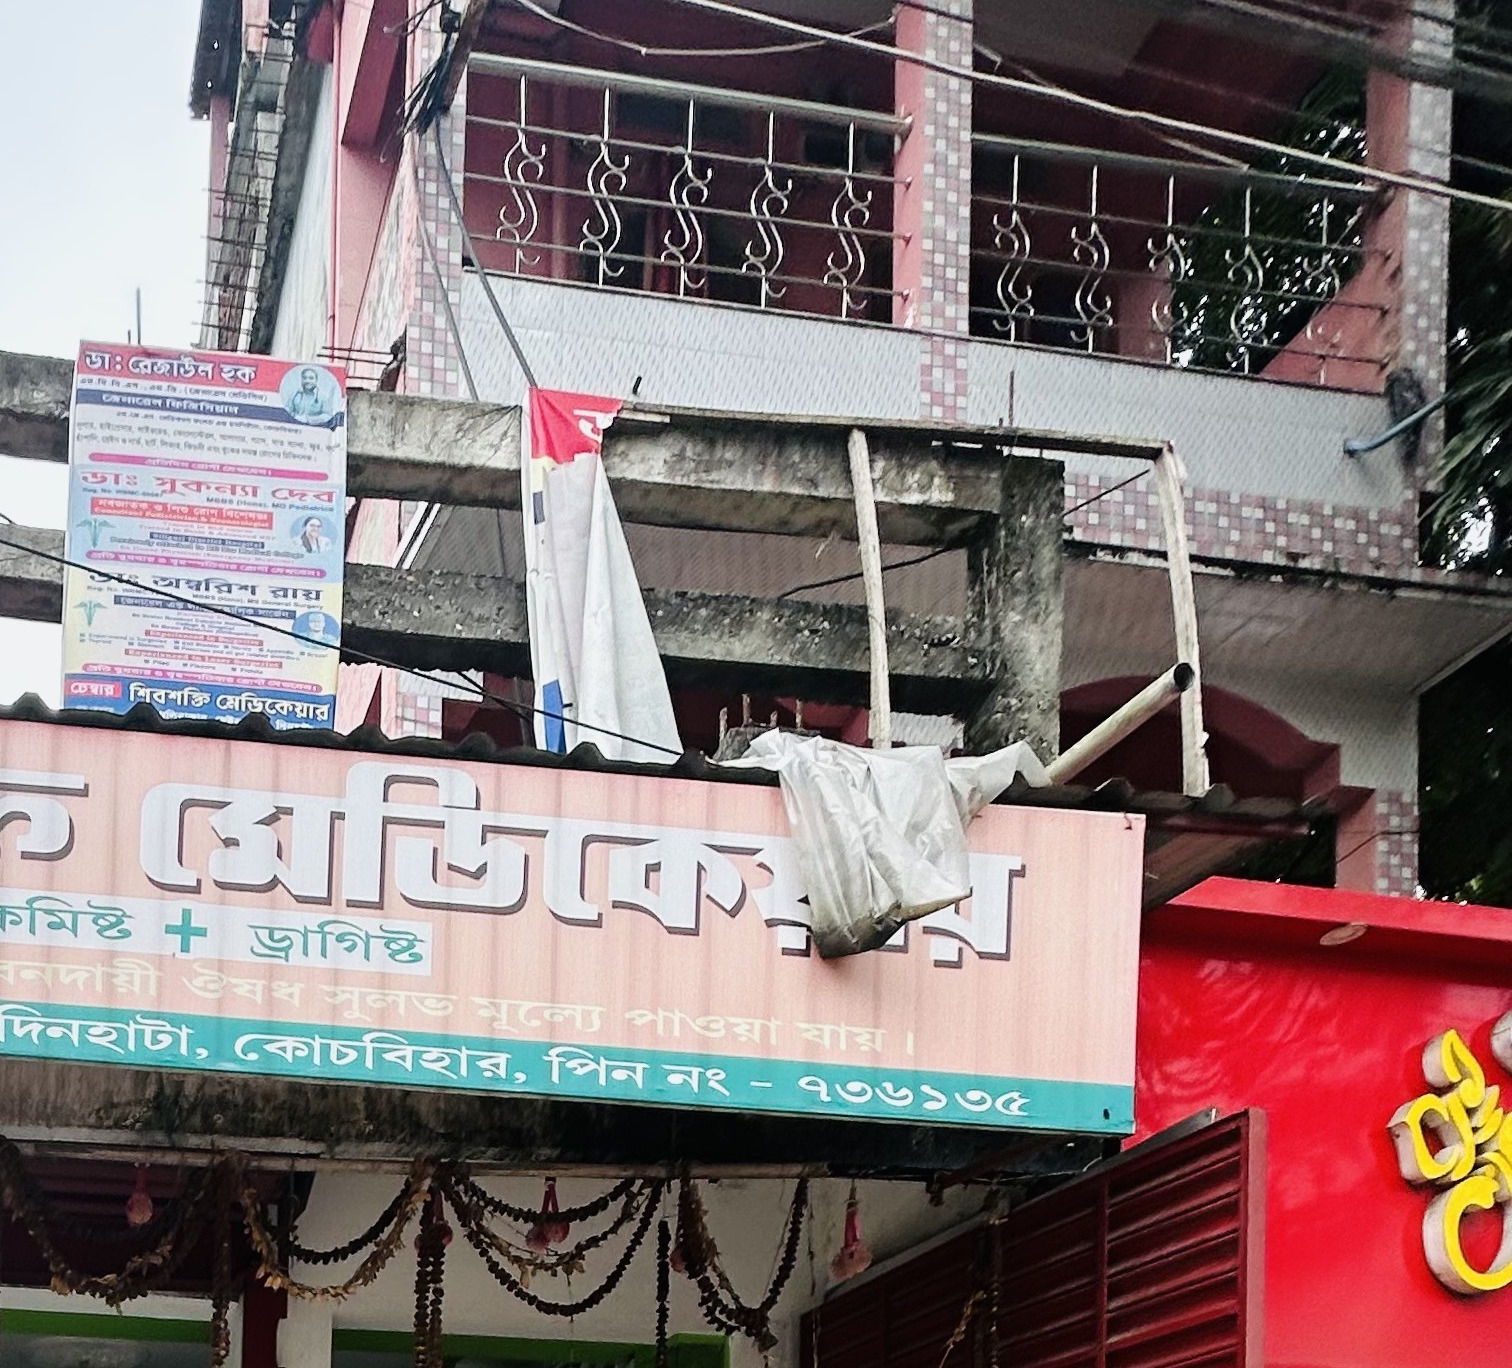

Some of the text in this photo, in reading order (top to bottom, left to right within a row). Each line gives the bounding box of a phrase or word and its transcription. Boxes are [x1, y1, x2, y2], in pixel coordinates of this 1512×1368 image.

[128, 353, 215, 380] রেজাউল
[220, 364, 257, 384] হক
[152, 475, 261, 498] সুকন্যা
[270, 487, 336, 503] দেব
[269, 585, 324, 602] রায়
[70, 682, 116, 697] চেম্বার
[128, 681, 212, 708] শিবশক্তি
[215, 691, 331, 722] মেডিকেয়ার
[247, 919, 427, 965] ড্রাগিষ্ট
[181, 957, 304, 1009] ঔষধ
[319, 982, 457, 1023] সুলভ
[470, 994, 607, 1035] মূল্যে
[624, 1005, 782, 1046] পাওয়া
[233, 1031, 528, 1086] কোচবিহার,
[542, 1045, 648, 1090] পিন
[660, 1063, 731, 1097] নং
[796, 1074, 1032, 1117] ৭৩৬১৩৫
